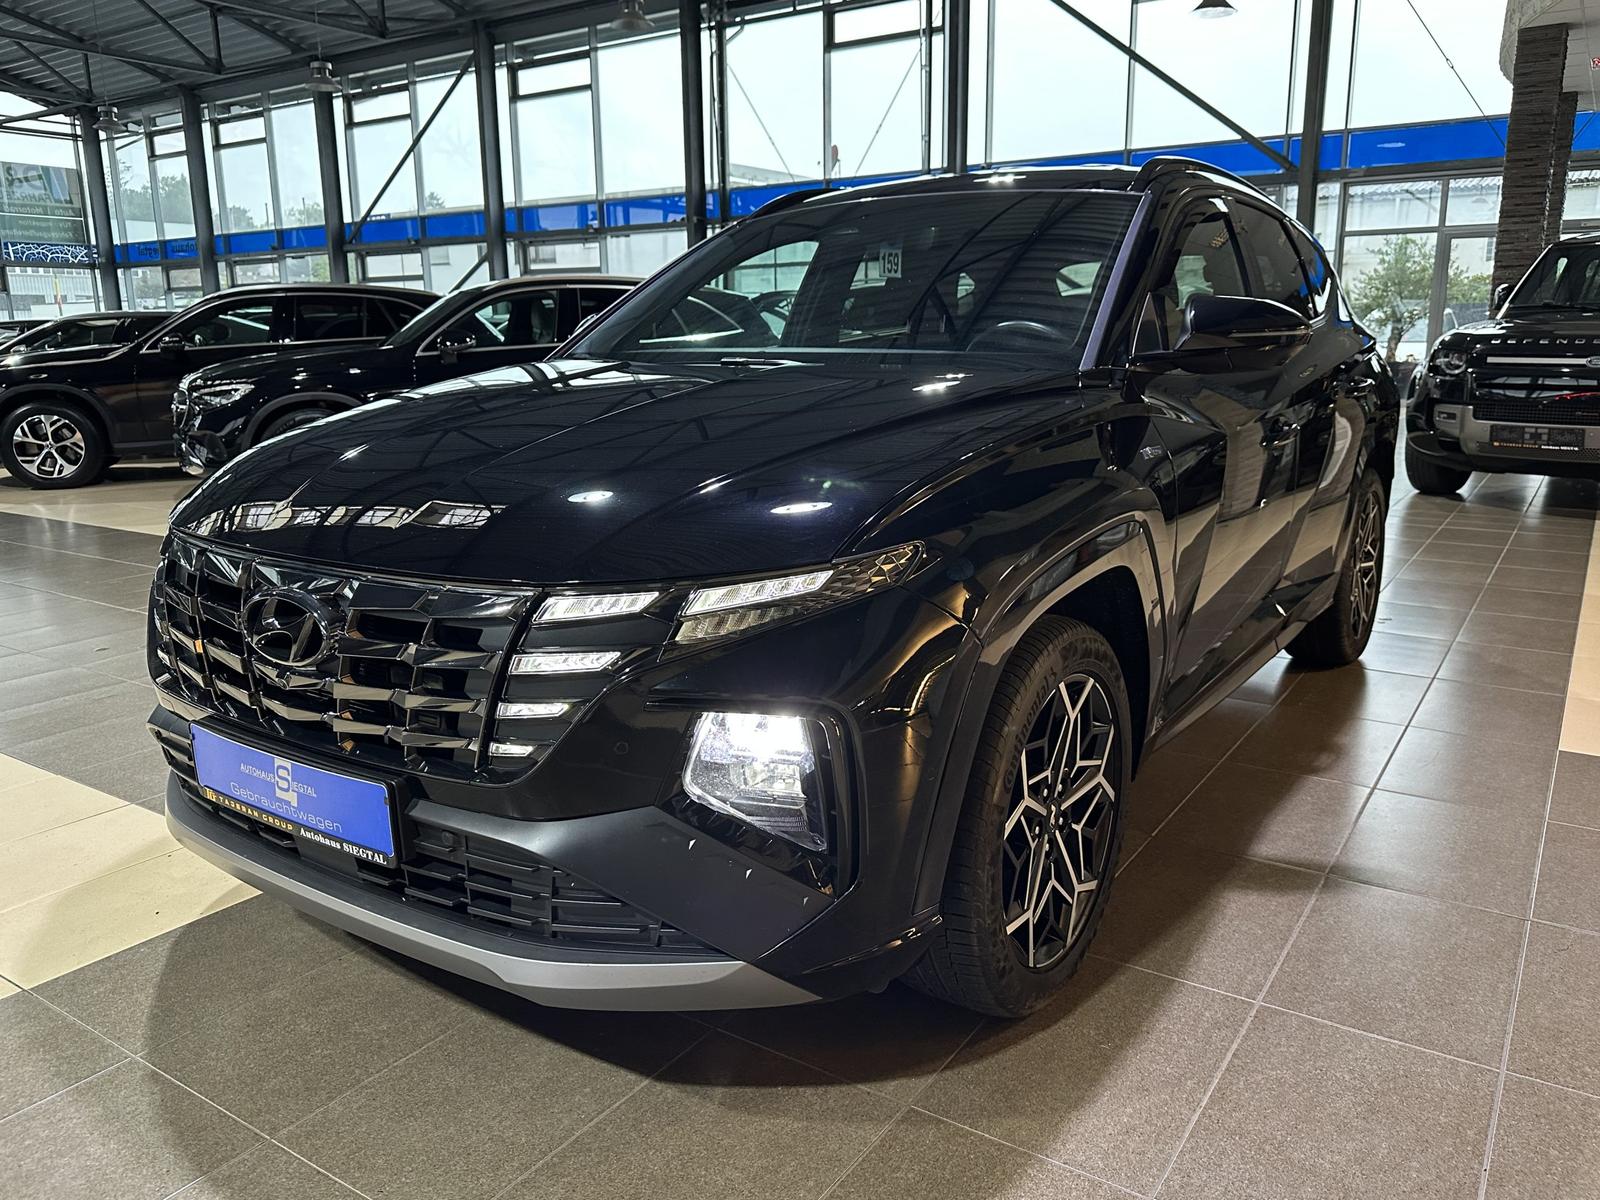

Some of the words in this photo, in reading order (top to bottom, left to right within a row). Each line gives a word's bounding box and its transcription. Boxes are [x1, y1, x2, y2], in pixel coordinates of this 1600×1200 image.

[881, 252, 900, 274] 159
[240, 763, 276, 783] AUTOHAUS
[230, 781, 342, 833] Gebrauchtwagen
[262, 814, 293, 830] GROUP
[300, 827, 341, 850] Autohaus
[342, 842, 387, 865] SIEGTAL
